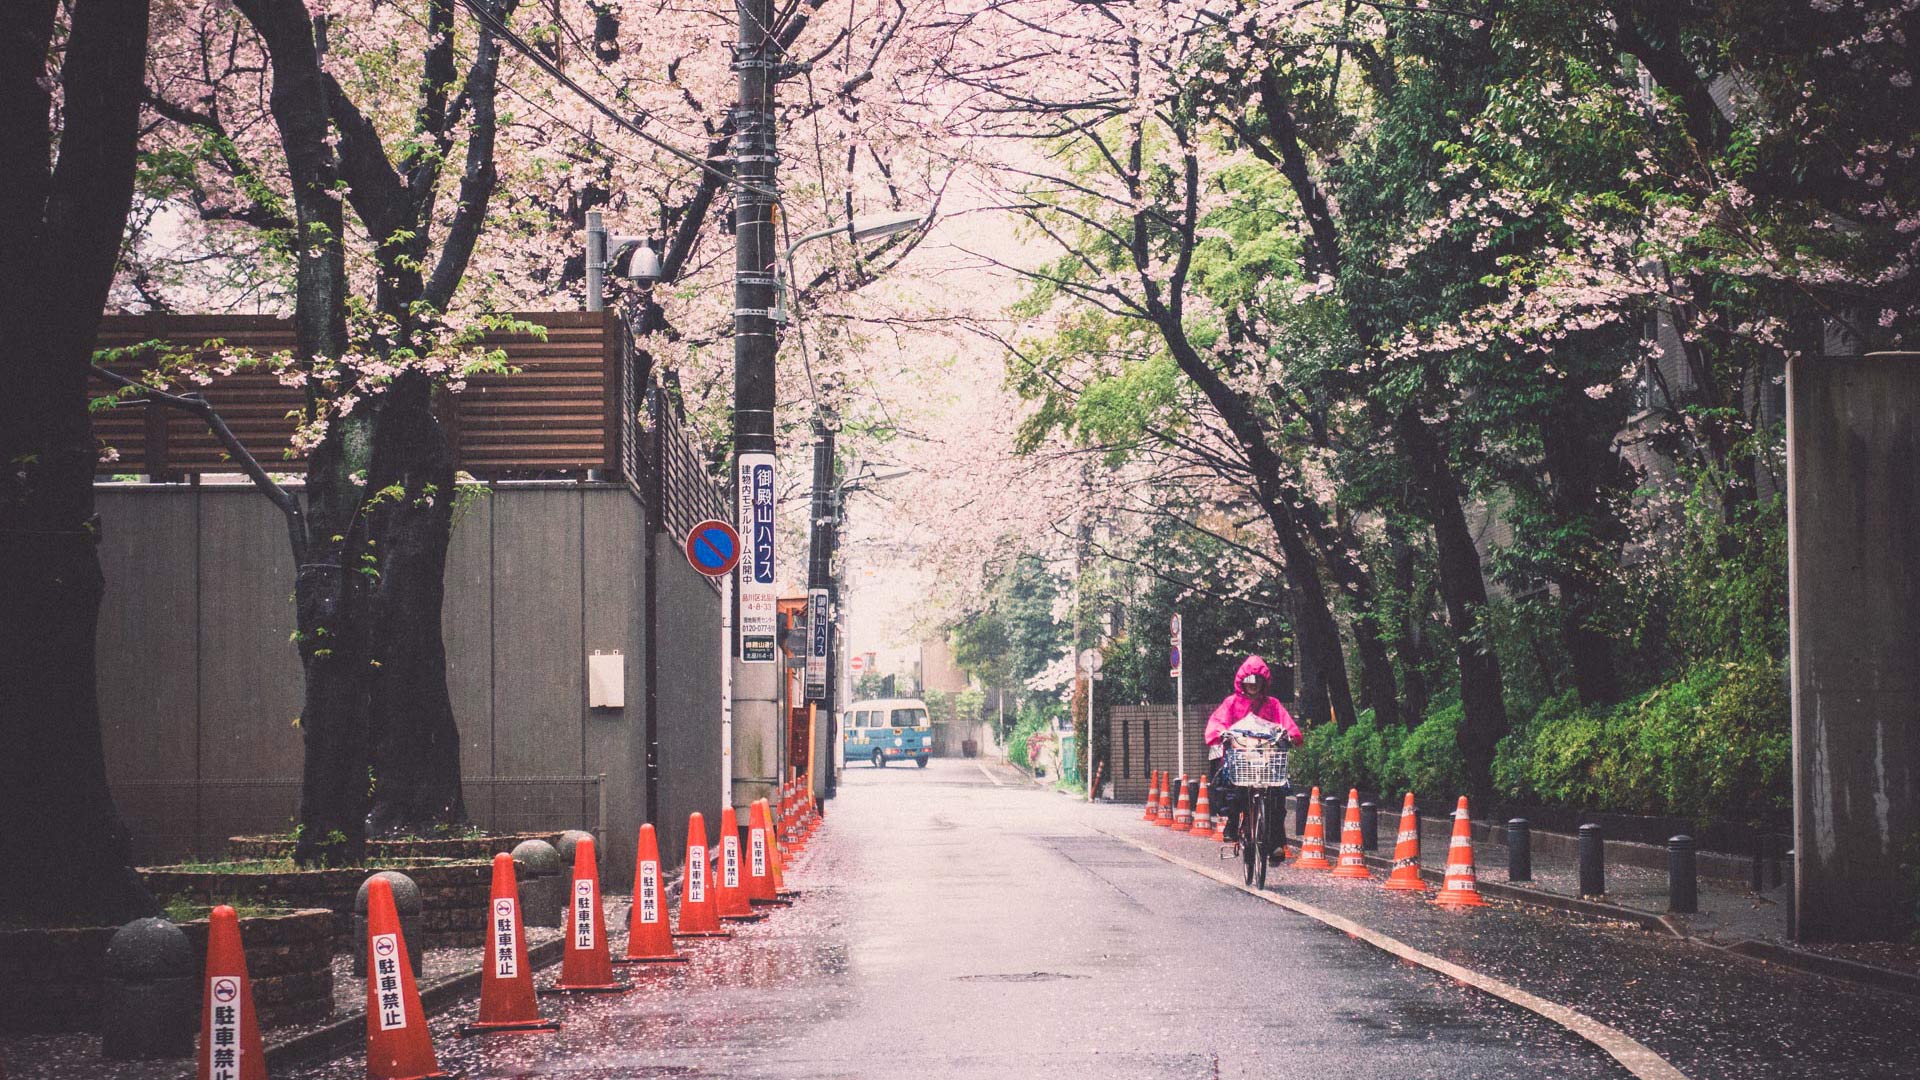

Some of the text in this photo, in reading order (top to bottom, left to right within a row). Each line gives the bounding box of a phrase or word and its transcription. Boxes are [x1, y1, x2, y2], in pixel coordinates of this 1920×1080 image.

[741, 465, 753, 585] 建物内モデルルーム公開中
[757, 469, 772, 579] 御殿山ハウス
[692, 860, 702, 900] 駐車禁止
[726, 849, 736, 886] 駐車禁止
[754, 841, 763, 874] 駐車禁止
[578, 897, 591, 947] 駐車禁止
[643, 876, 655, 921] 駐車禁止
[497, 918, 513, 975] 駐車禁止
[378, 958, 402, 1026] 駐車禁止
